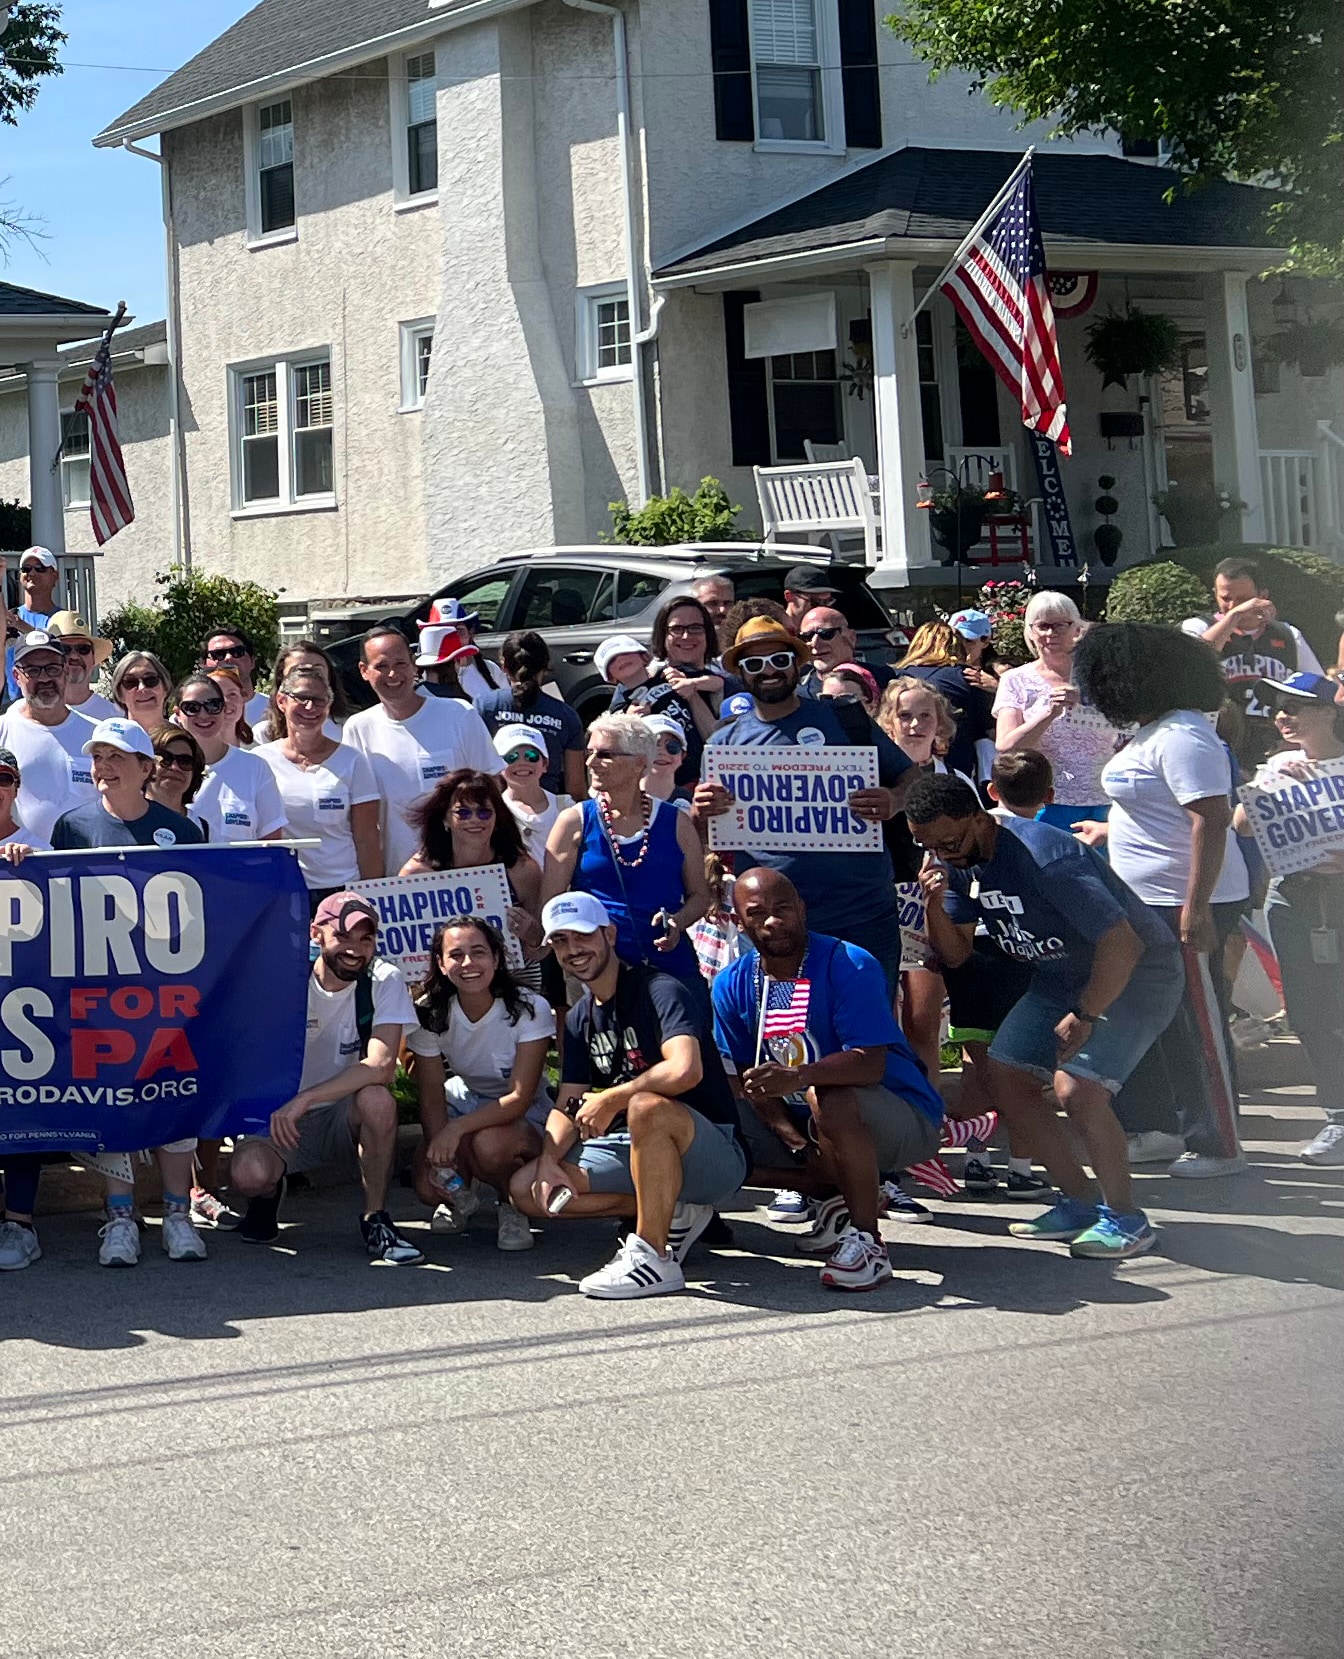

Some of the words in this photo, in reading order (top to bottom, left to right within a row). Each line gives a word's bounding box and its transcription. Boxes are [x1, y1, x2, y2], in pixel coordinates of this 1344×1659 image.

[495, 711, 524, 722] JOIN
[1256, 776, 1344, 820] SHAPIR
[70, 985, 200, 1019] FOR
[70, 1027, 199, 1079] PA
